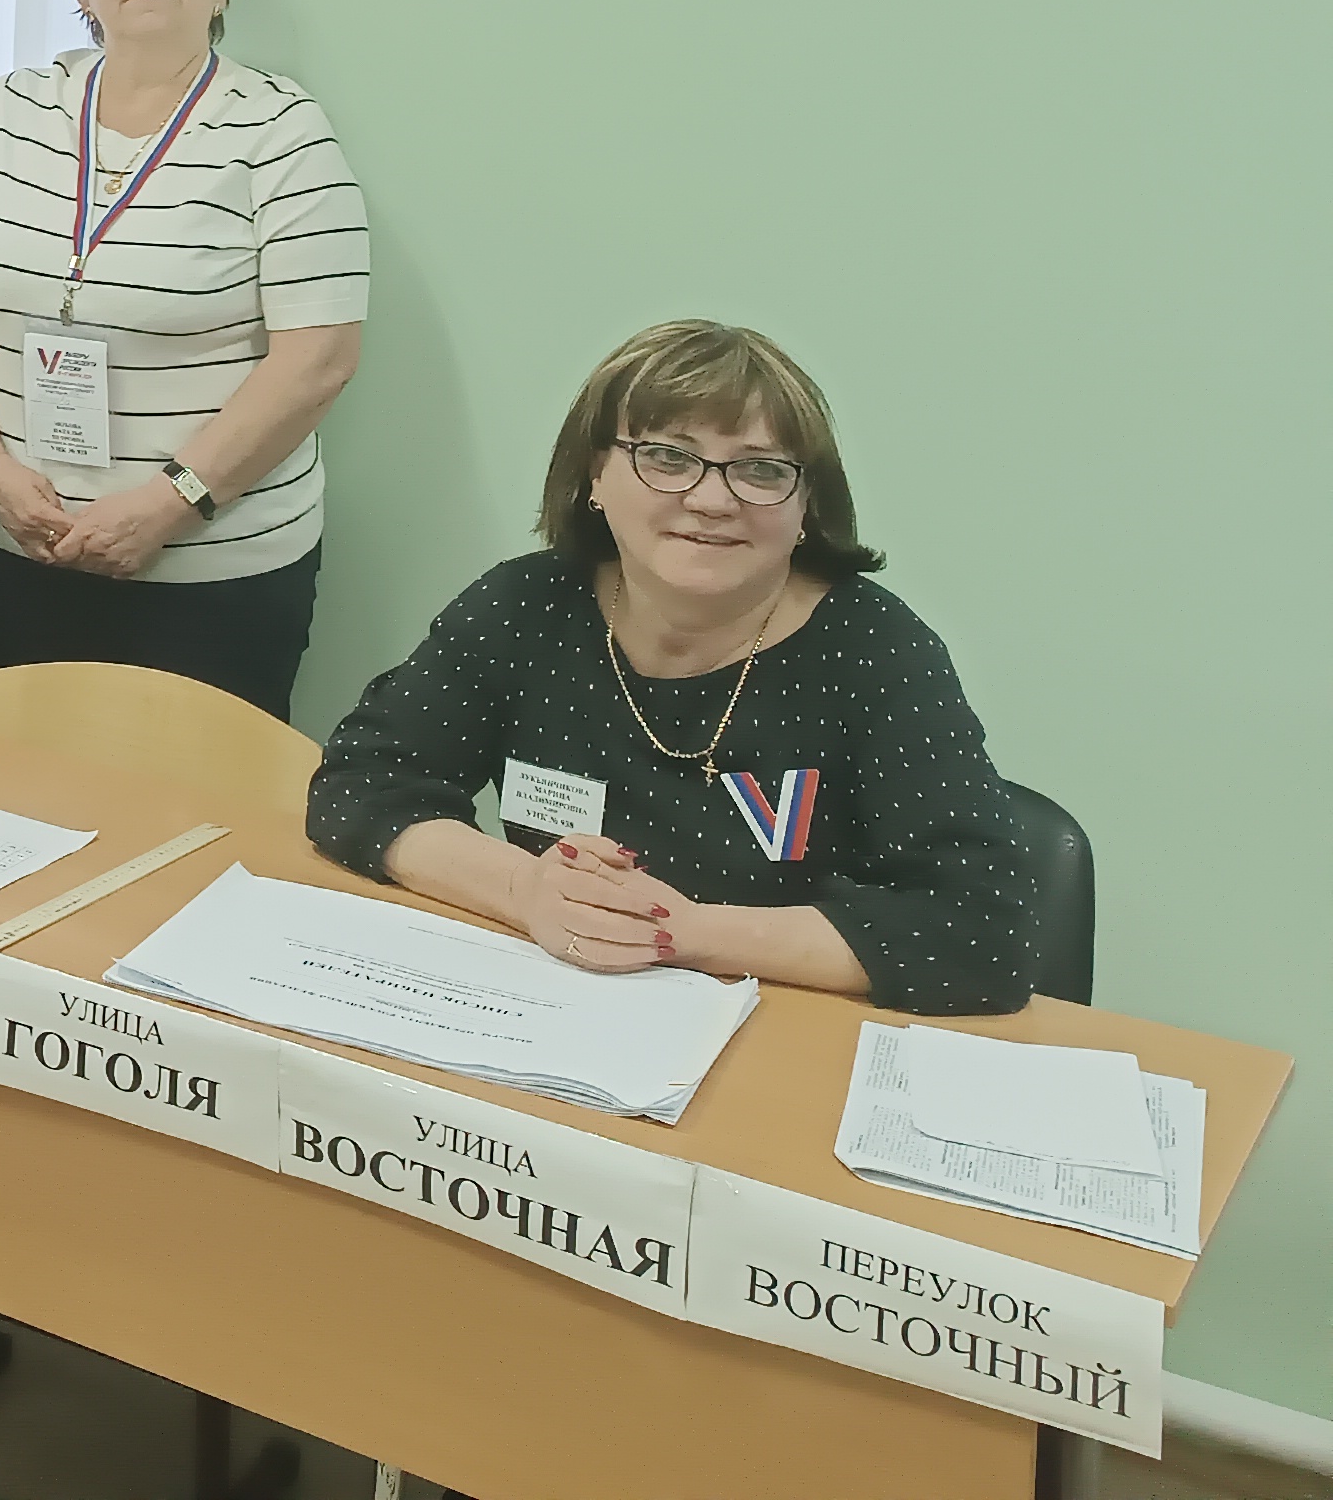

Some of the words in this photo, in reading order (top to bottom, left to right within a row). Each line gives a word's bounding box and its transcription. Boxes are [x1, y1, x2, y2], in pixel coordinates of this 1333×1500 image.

[534, 785, 571, 802] МАРИНА
[58, 990, 166, 1048] УЛИЦА
[2, 1018, 222, 1122] ГОГОЛЯ
[411, 1114, 538, 1182] УЛИЦА
[291, 1119, 678, 1290] ВОСТОЧНАЯ
[819, 1238, 1052, 1338] ПЕРЕУЛОК
[744, 1266, 1132, 1419] ВОСТОЧНЫЙ
